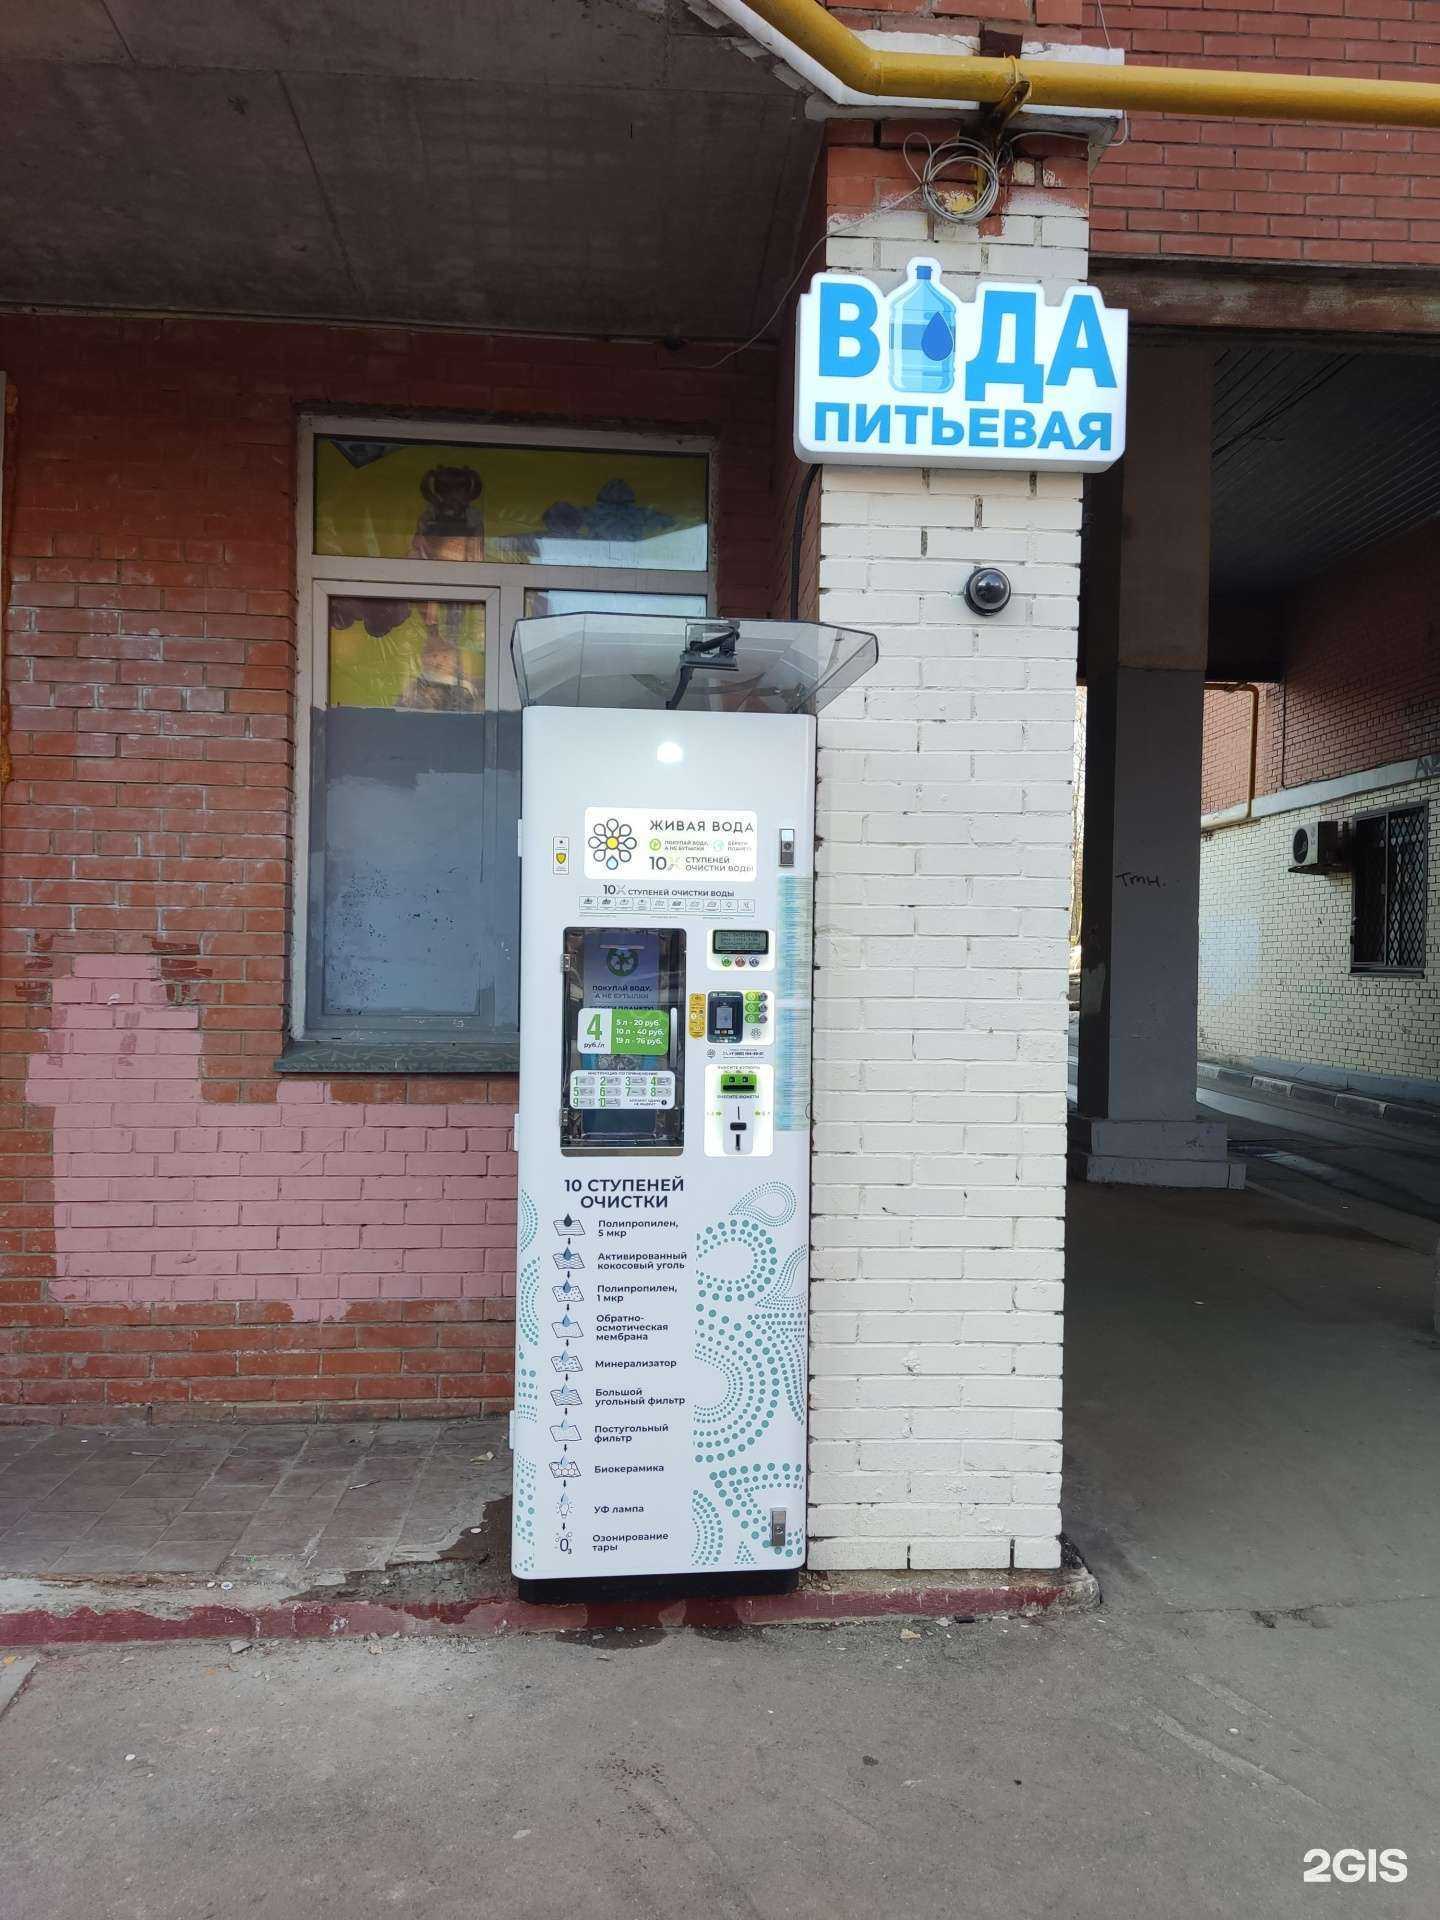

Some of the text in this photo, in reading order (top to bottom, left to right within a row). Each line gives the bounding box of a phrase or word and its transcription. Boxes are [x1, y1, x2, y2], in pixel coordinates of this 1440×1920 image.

[819, 280, 1117, 403] ВДА
[815, 402, 1112, 451] ПИТЬЕВАЯ
[649, 820, 754, 833] ЖИВАЯ ВОДА
[685, 855, 730, 864] СТУПЕНЕЙ
[685, 864, 754, 873] ОЧИСТКИ ВОДЫ
[628, 888, 670, 896] СТУПЕНЕЙ
[671, 889, 709, 897] ОЧИСТКИ
[592, 984, 628, 992] ПОКУПАЙ
[586, 1013, 603, 1041] 4
[644, 1020, 661, 1028] руб.
[648, 1029, 665, 1037] руб.
[573, 1077, 579, 1086] 1
[600, 1077, 606, 1086] 2
[625, 1077, 631, 1086] 3
[651, 1077, 657, 1086] 4
[573, 1087, 657, 1097] 5 6 7 8
[572, 1097, 579, 1107] 9
[564, 1176, 685, 1192] 10 СТУПЕНЕЙ
[580, 1194, 669, 1208] ОЧИСТКИ
[598, 1219, 679, 1230] Полипропилен,
[598, 1229, 627, 1238] 5 мкр
[597, 1251, 687, 1261] Активированный
[597, 1261, 685, 1271] кокосовый уголь
[597, 1284, 678, 1294] Полипропилен,
[596, 1294, 624, 1304] 1 мкр
[596, 1314, 645, 1324] Обратно-
[596, 1323, 668, 1332] осмотическая
[596, 1331, 648, 1341] мембрана
[595, 1359, 677, 1369] Минерализатор
[595, 1387, 643, 1397] Большой
[594, 1395, 686, 1407] угольный фильтр
[594, 1424, 669, 1434] Постугольный
[594, 1433, 632, 1443] фильтр
[594, 1464, 665, 1474] Биокерамика
[594, 1504, 645, 1514] УФ лампа
[592, 1532, 669, 1543] Озонирование
[592, 1543, 618, 1553] тары
